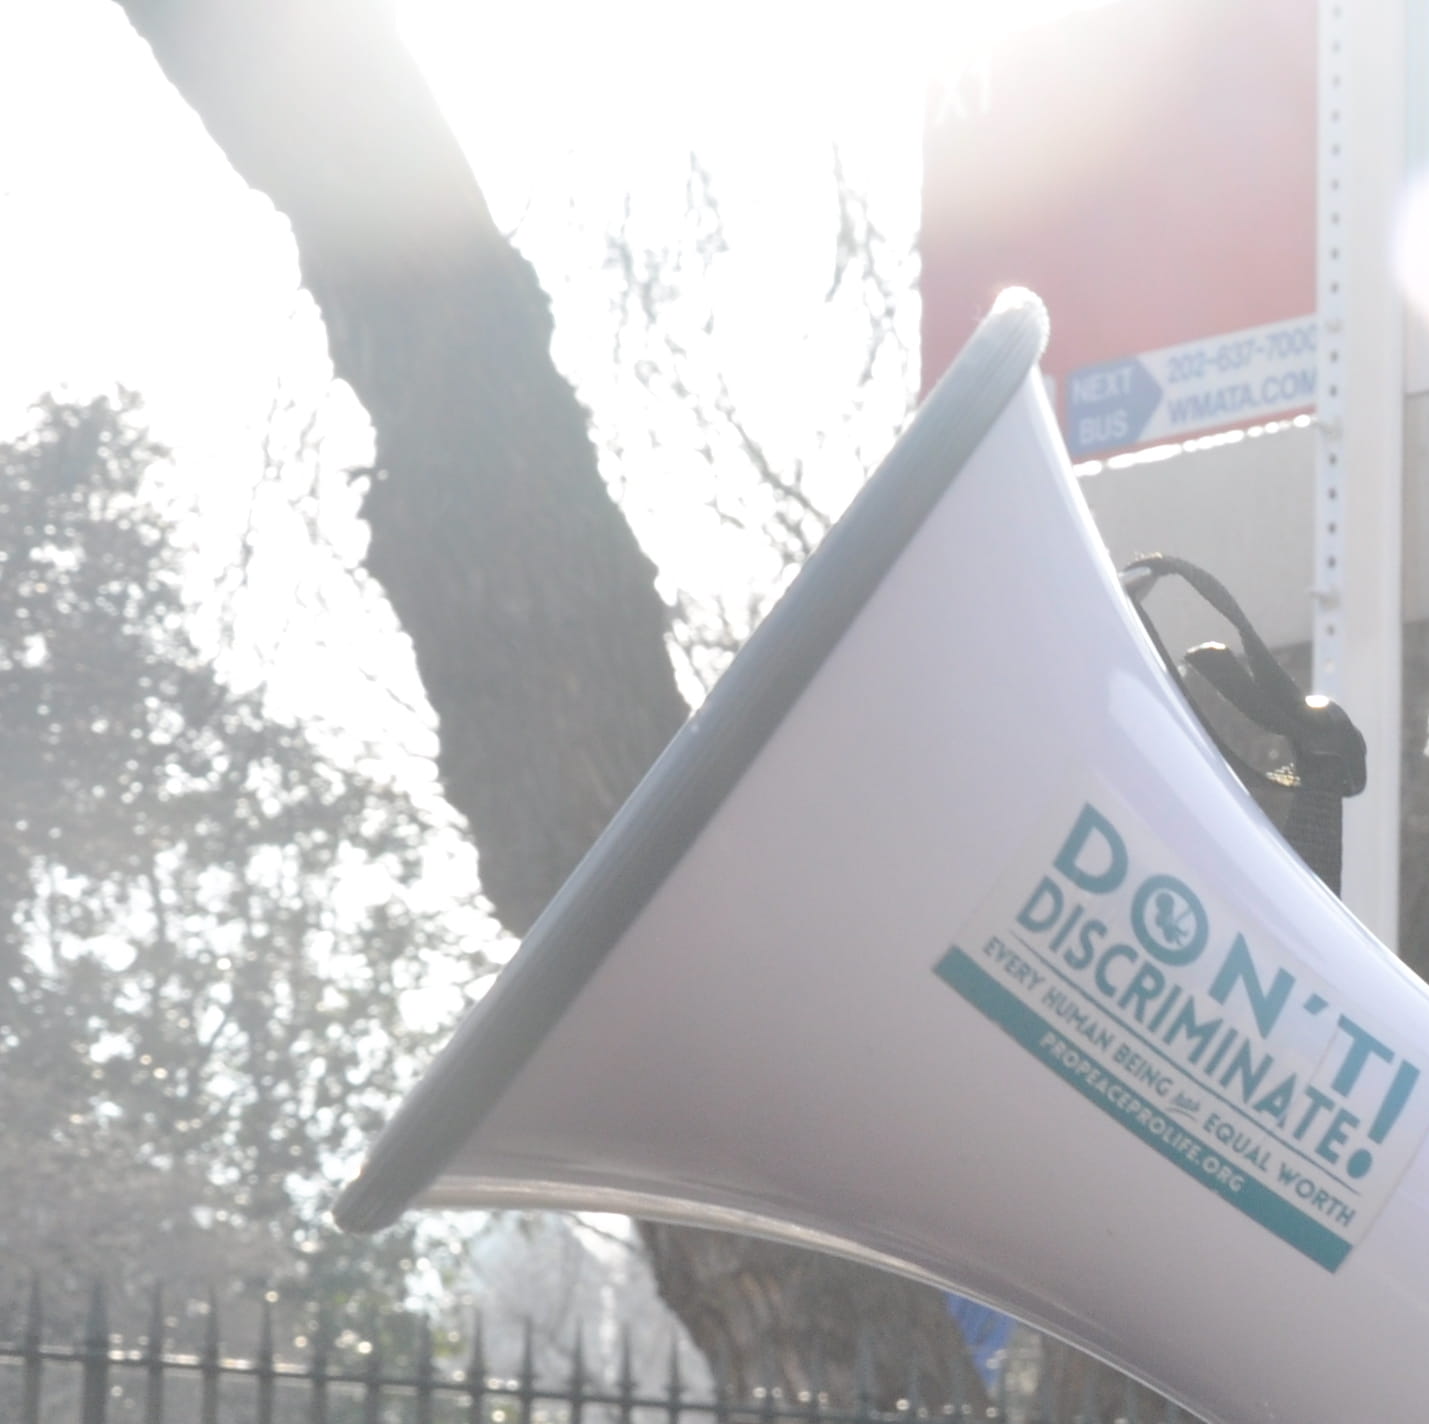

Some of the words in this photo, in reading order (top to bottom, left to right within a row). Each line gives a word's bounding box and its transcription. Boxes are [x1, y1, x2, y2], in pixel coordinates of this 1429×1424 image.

[1072, 366, 1135, 404] NEXT
[1079, 410, 1130, 446] BUS
[983, 935, 1045, 991] EVERY
[1041, 986, 1115, 1050] HUMAN
[1112, 1042, 1174, 1097] BEING
[1202, 1112, 1272, 1172] EQUAL
[1278, 1161, 1356, 1228] WORTH
[1039, 1031, 1246, 1194] PROPEACEPROLIFE.ORG
